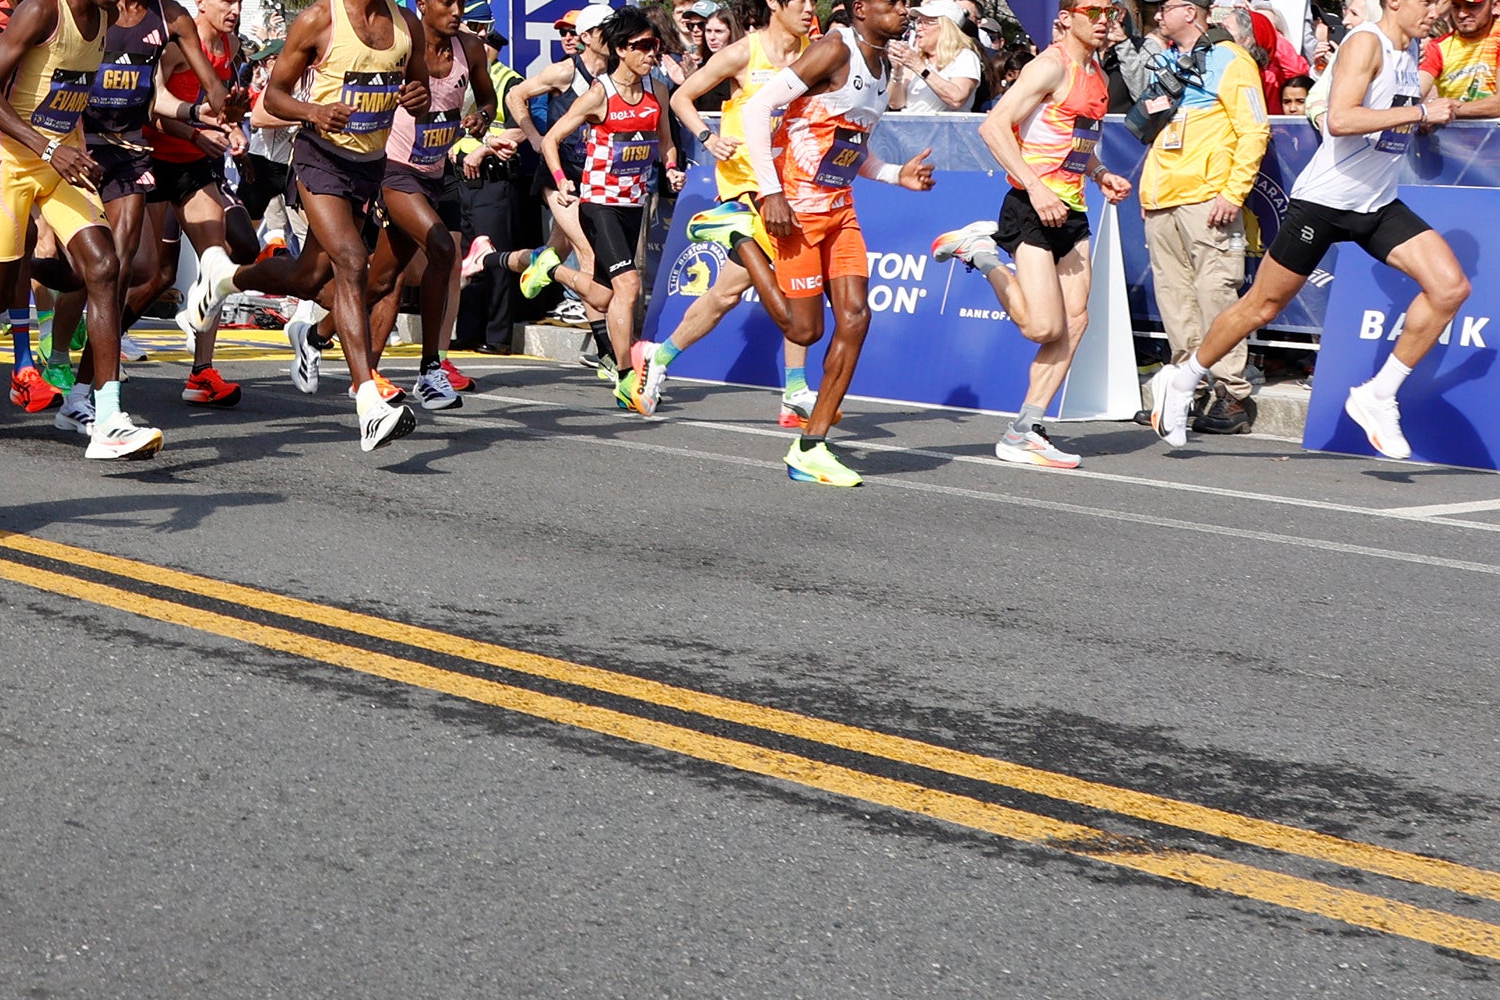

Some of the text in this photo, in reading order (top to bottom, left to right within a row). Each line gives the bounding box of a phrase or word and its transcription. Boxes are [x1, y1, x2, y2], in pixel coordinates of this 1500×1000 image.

[102, 69, 140, 90] GEAY
[622, 145, 651, 162] OTSU
[670, 270, 679, 288] THE
[678, 243, 708, 265] BOSTON
[959, 308, 1006, 320] BANK OF
